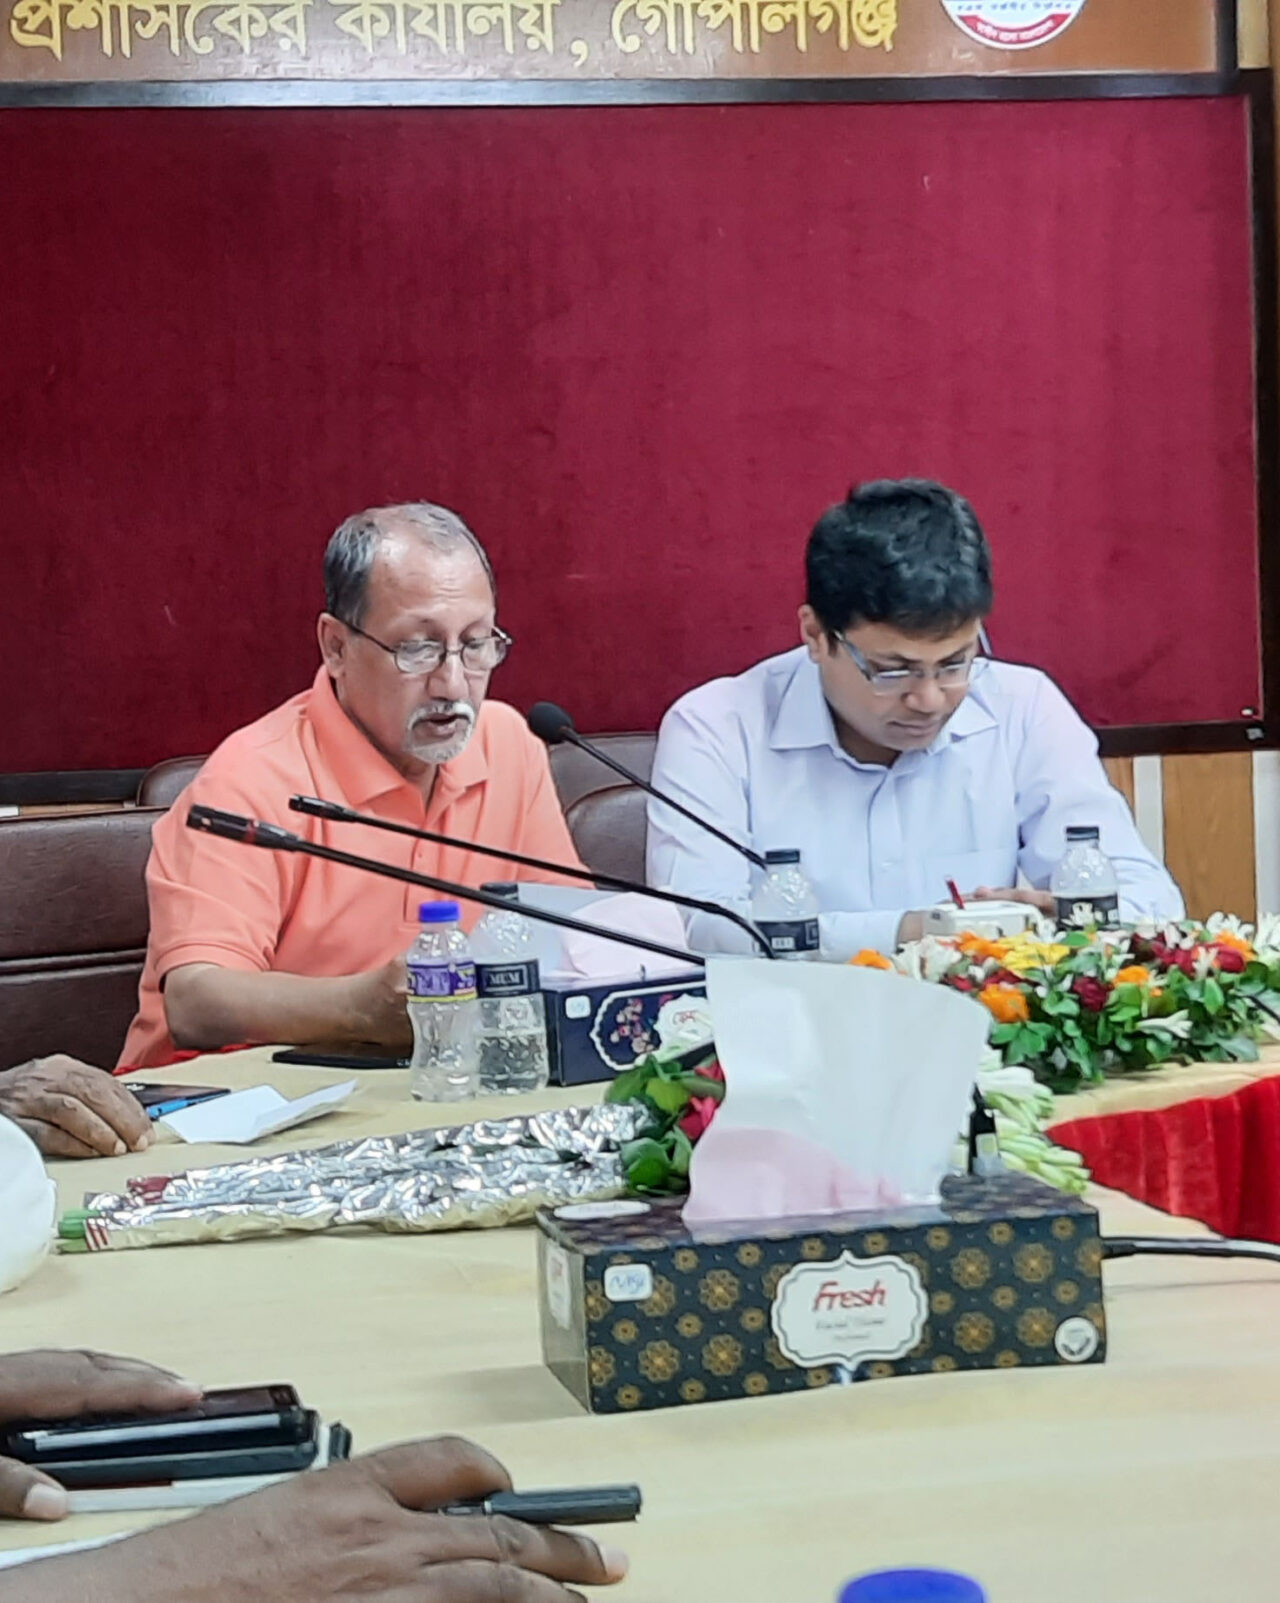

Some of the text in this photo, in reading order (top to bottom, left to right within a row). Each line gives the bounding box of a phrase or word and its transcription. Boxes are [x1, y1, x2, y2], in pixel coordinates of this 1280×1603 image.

[8, 0, 314, 62] প্রশাসকের
[611, 0, 898, 53] গোপালগঞ্জ
[812, 1280, 886, 1313] Fresh
